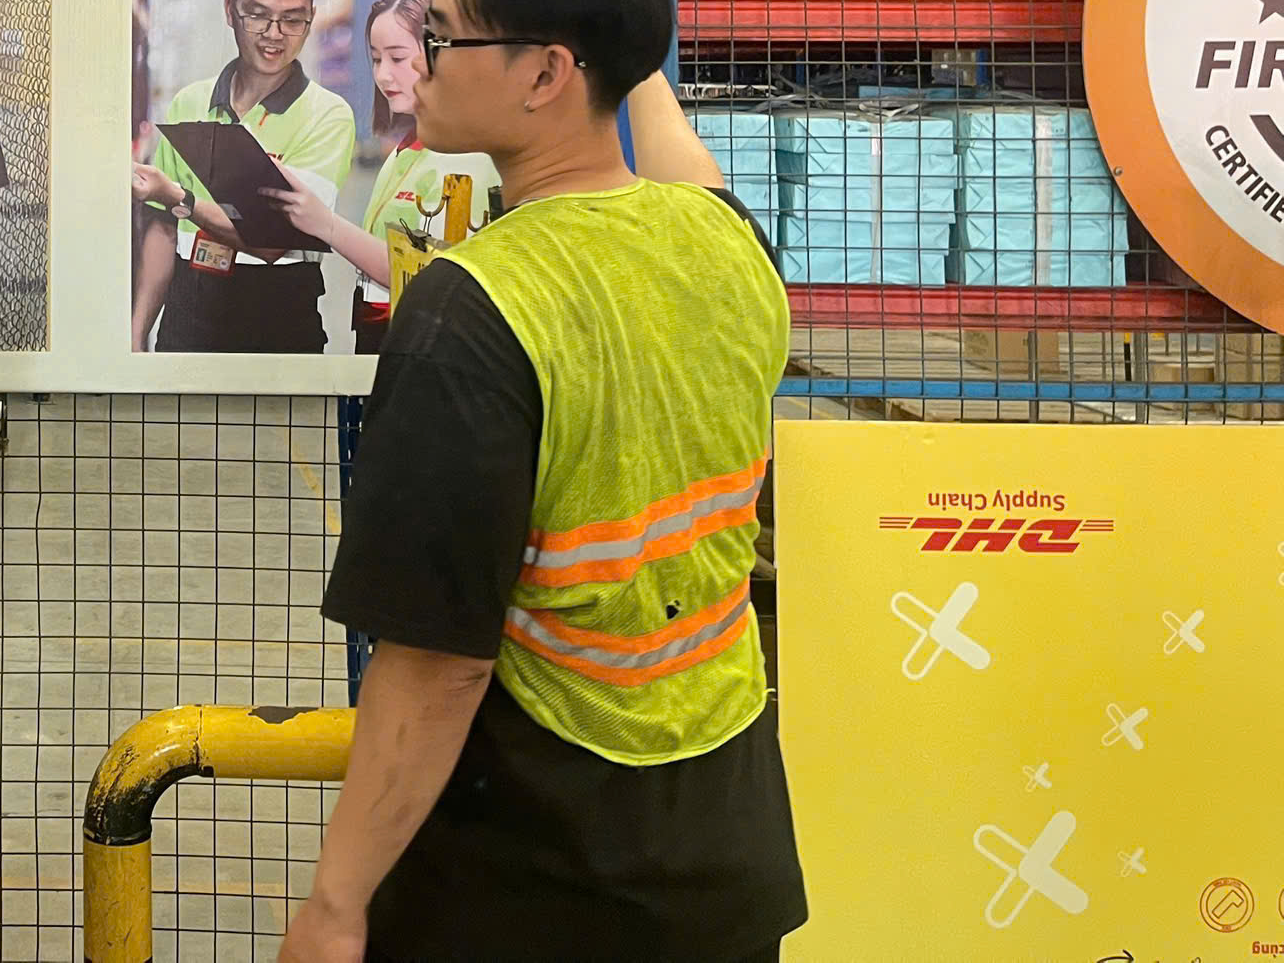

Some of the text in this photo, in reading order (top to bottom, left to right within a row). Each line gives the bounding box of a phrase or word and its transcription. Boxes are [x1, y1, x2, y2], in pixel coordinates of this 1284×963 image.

[927, 489, 1065, 512] Supply Chain
[910, 517, 1083, 553] DHL
